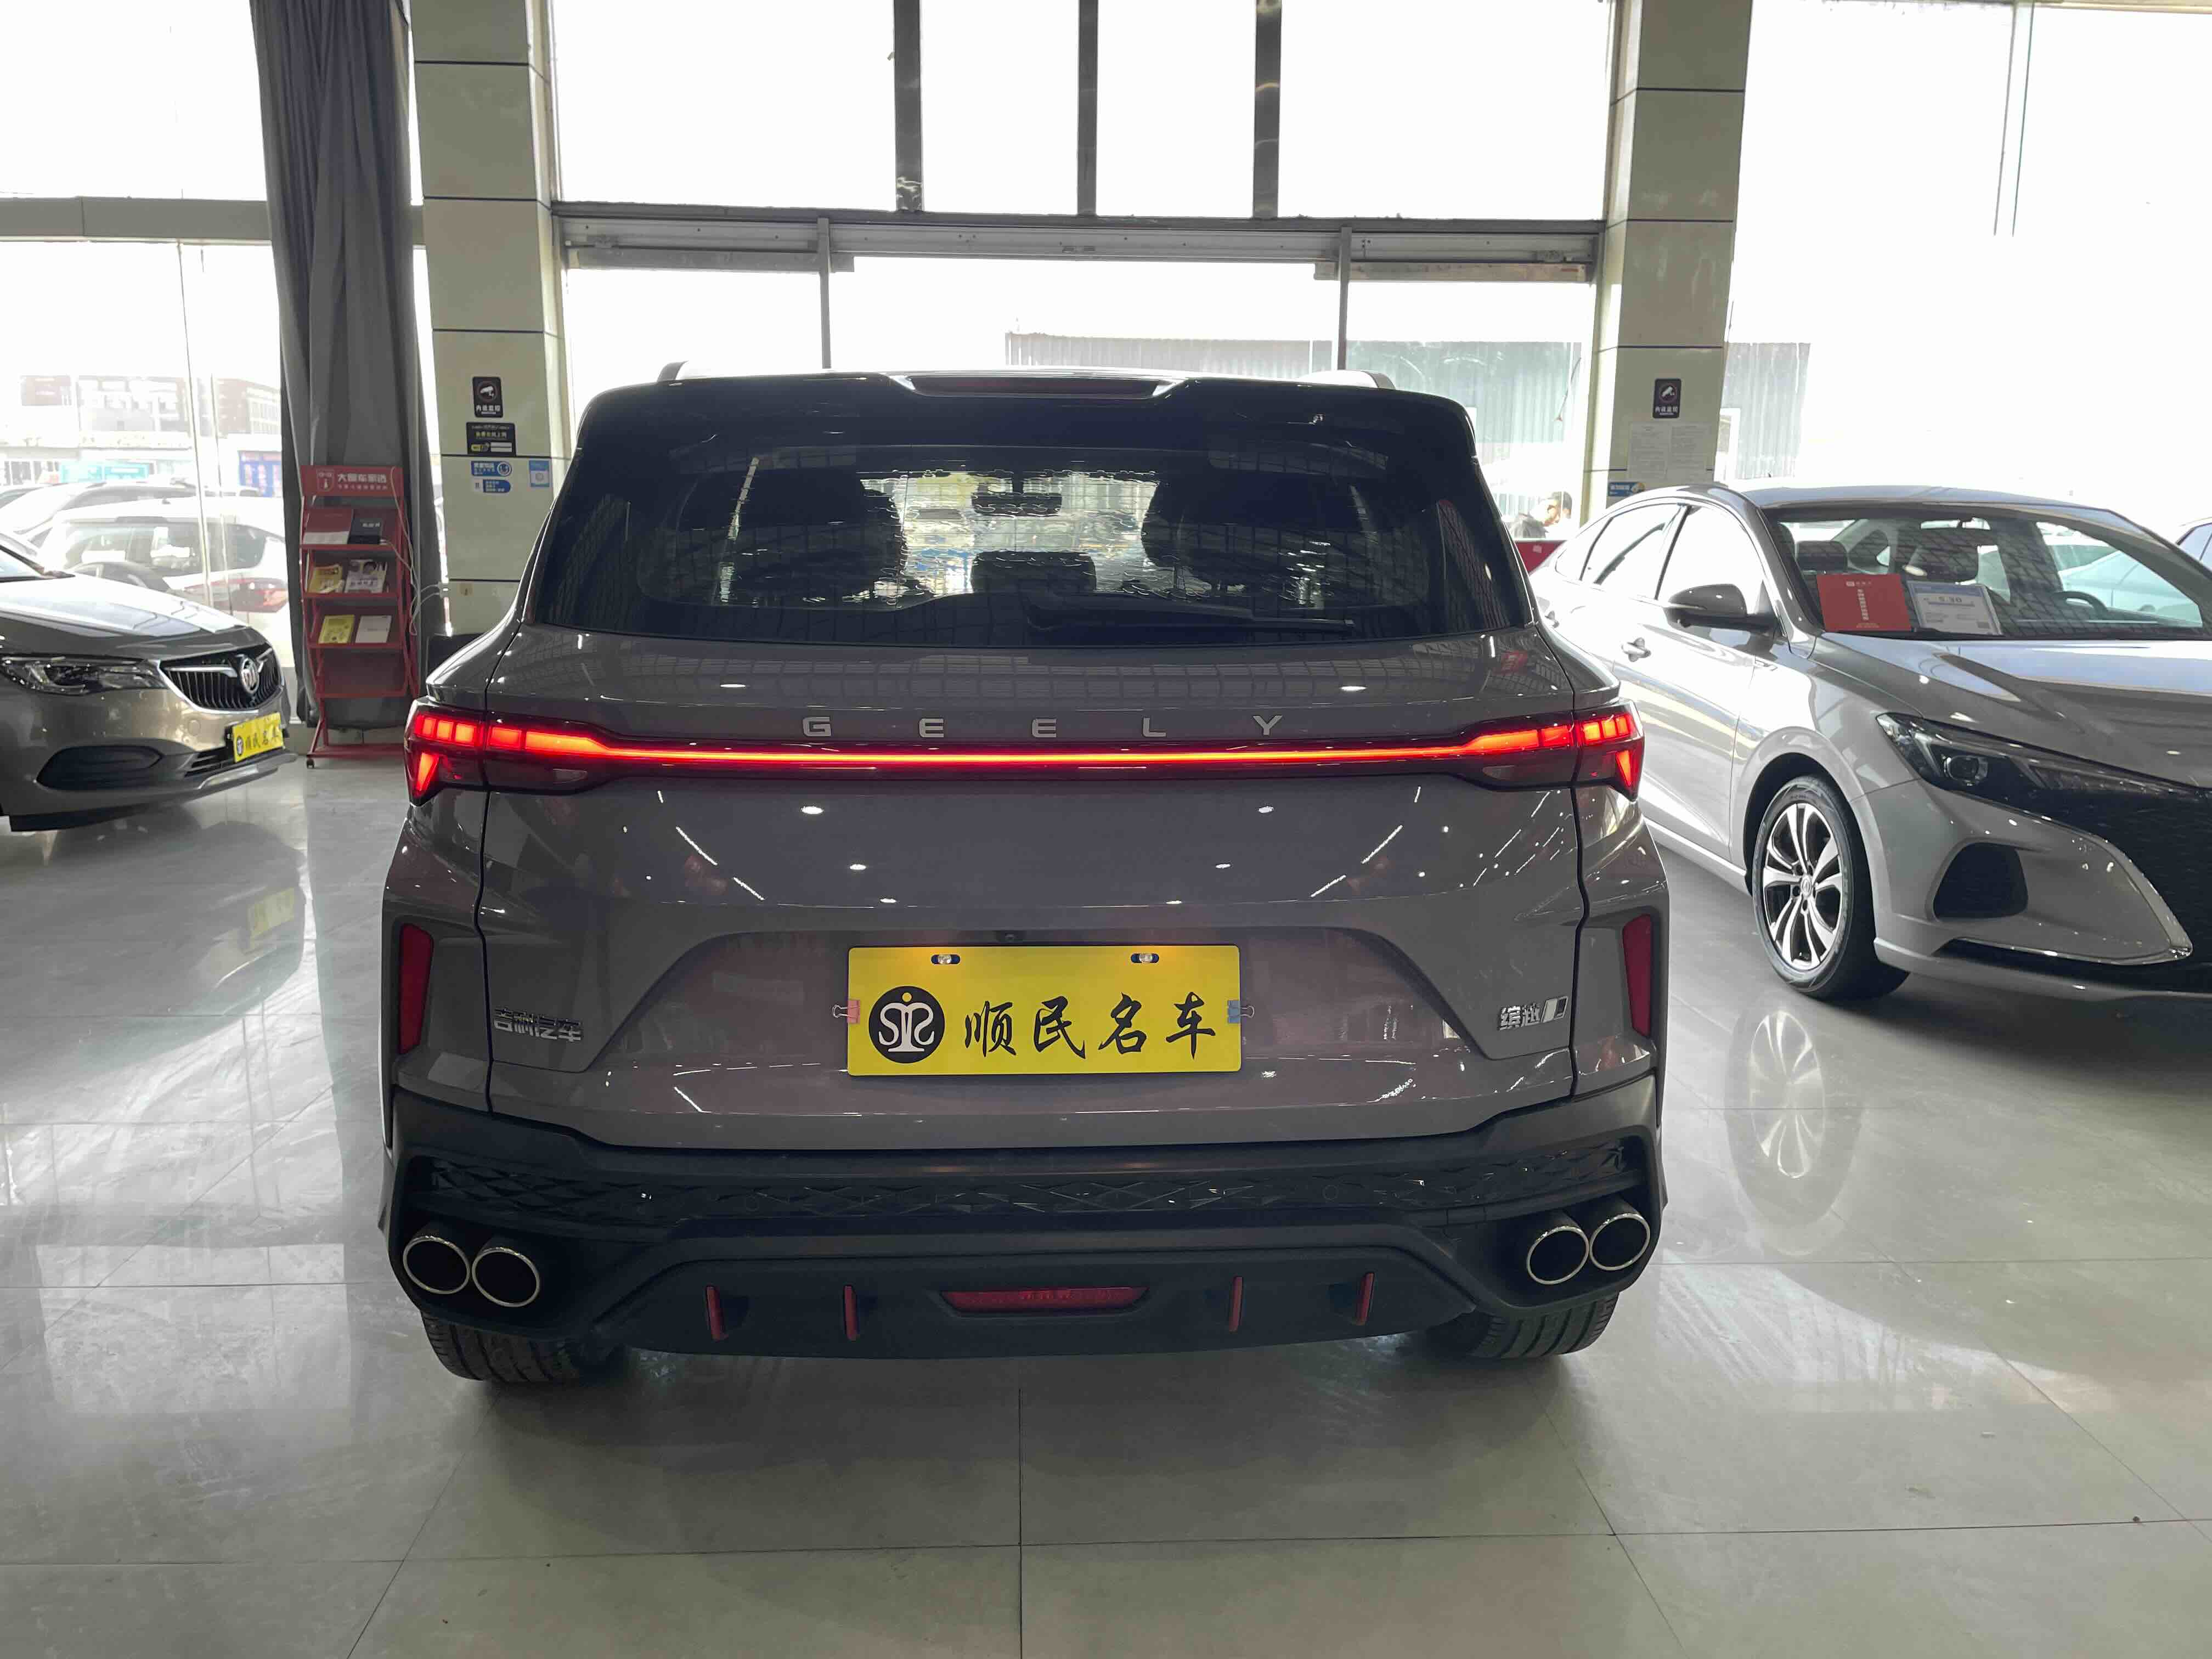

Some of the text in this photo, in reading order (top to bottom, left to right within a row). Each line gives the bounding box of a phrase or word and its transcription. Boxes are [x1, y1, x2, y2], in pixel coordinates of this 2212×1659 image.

[803, 715, 1283, 738] GEELY
[964, 991, 1216, 1060] 顺民名车
